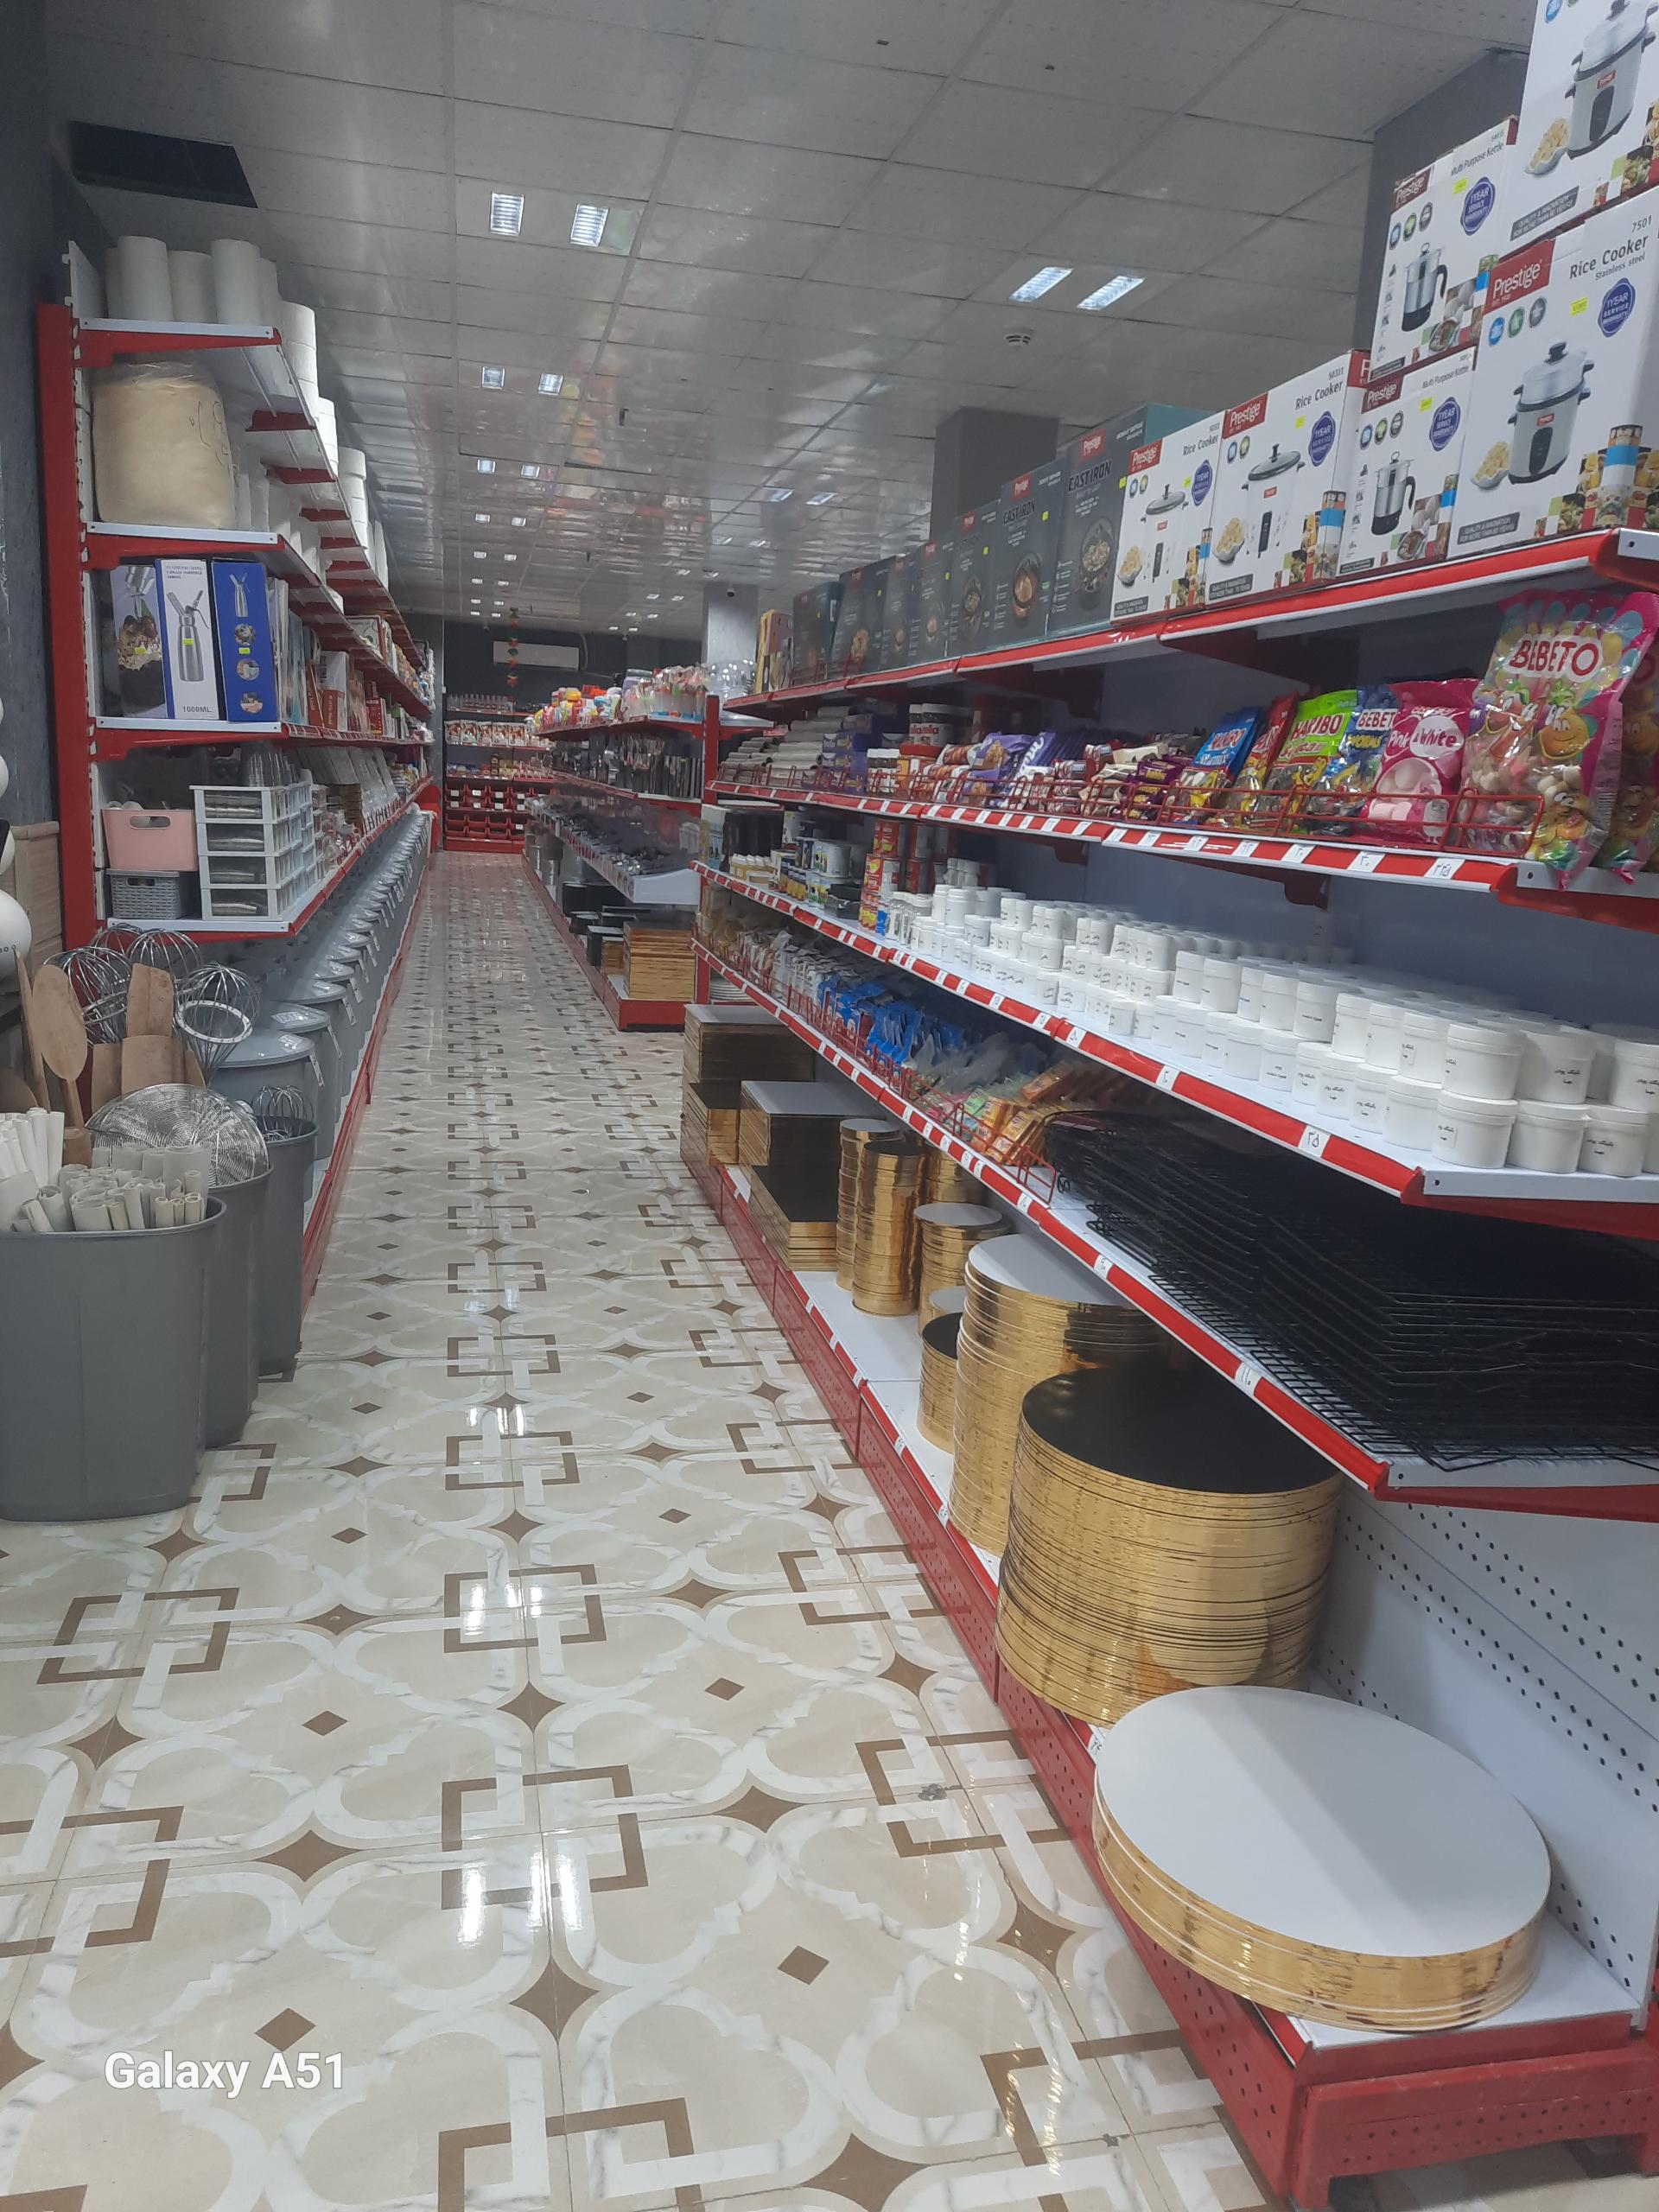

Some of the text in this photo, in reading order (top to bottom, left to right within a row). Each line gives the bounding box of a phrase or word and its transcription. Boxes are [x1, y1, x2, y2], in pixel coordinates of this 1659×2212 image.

[1632, 214, 1652, 233] 7501
[1570, 235, 1649, 279] Rice Cooker
[1493, 263, 1541, 299] Prestige
[1595, 262, 1625, 281] Stainless
[1296, 381, 1344, 410] Rice Cooker
[1230, 403, 1261, 428] Prestige
[1132, 447, 1158, 467] Prestige
[1183, 434, 1219, 456] Rice Cooker
[1068, 473, 1090, 492] CAST
[1090, 461, 1112, 481] IRON
[1510, 639, 1599, 676] BEBETO
[1290, 714, 1344, 741] HARIBO
[1357, 711, 1395, 728] BEBET
[1389, 730, 1410, 748] Pink
[1421, 728, 1458, 748] White
